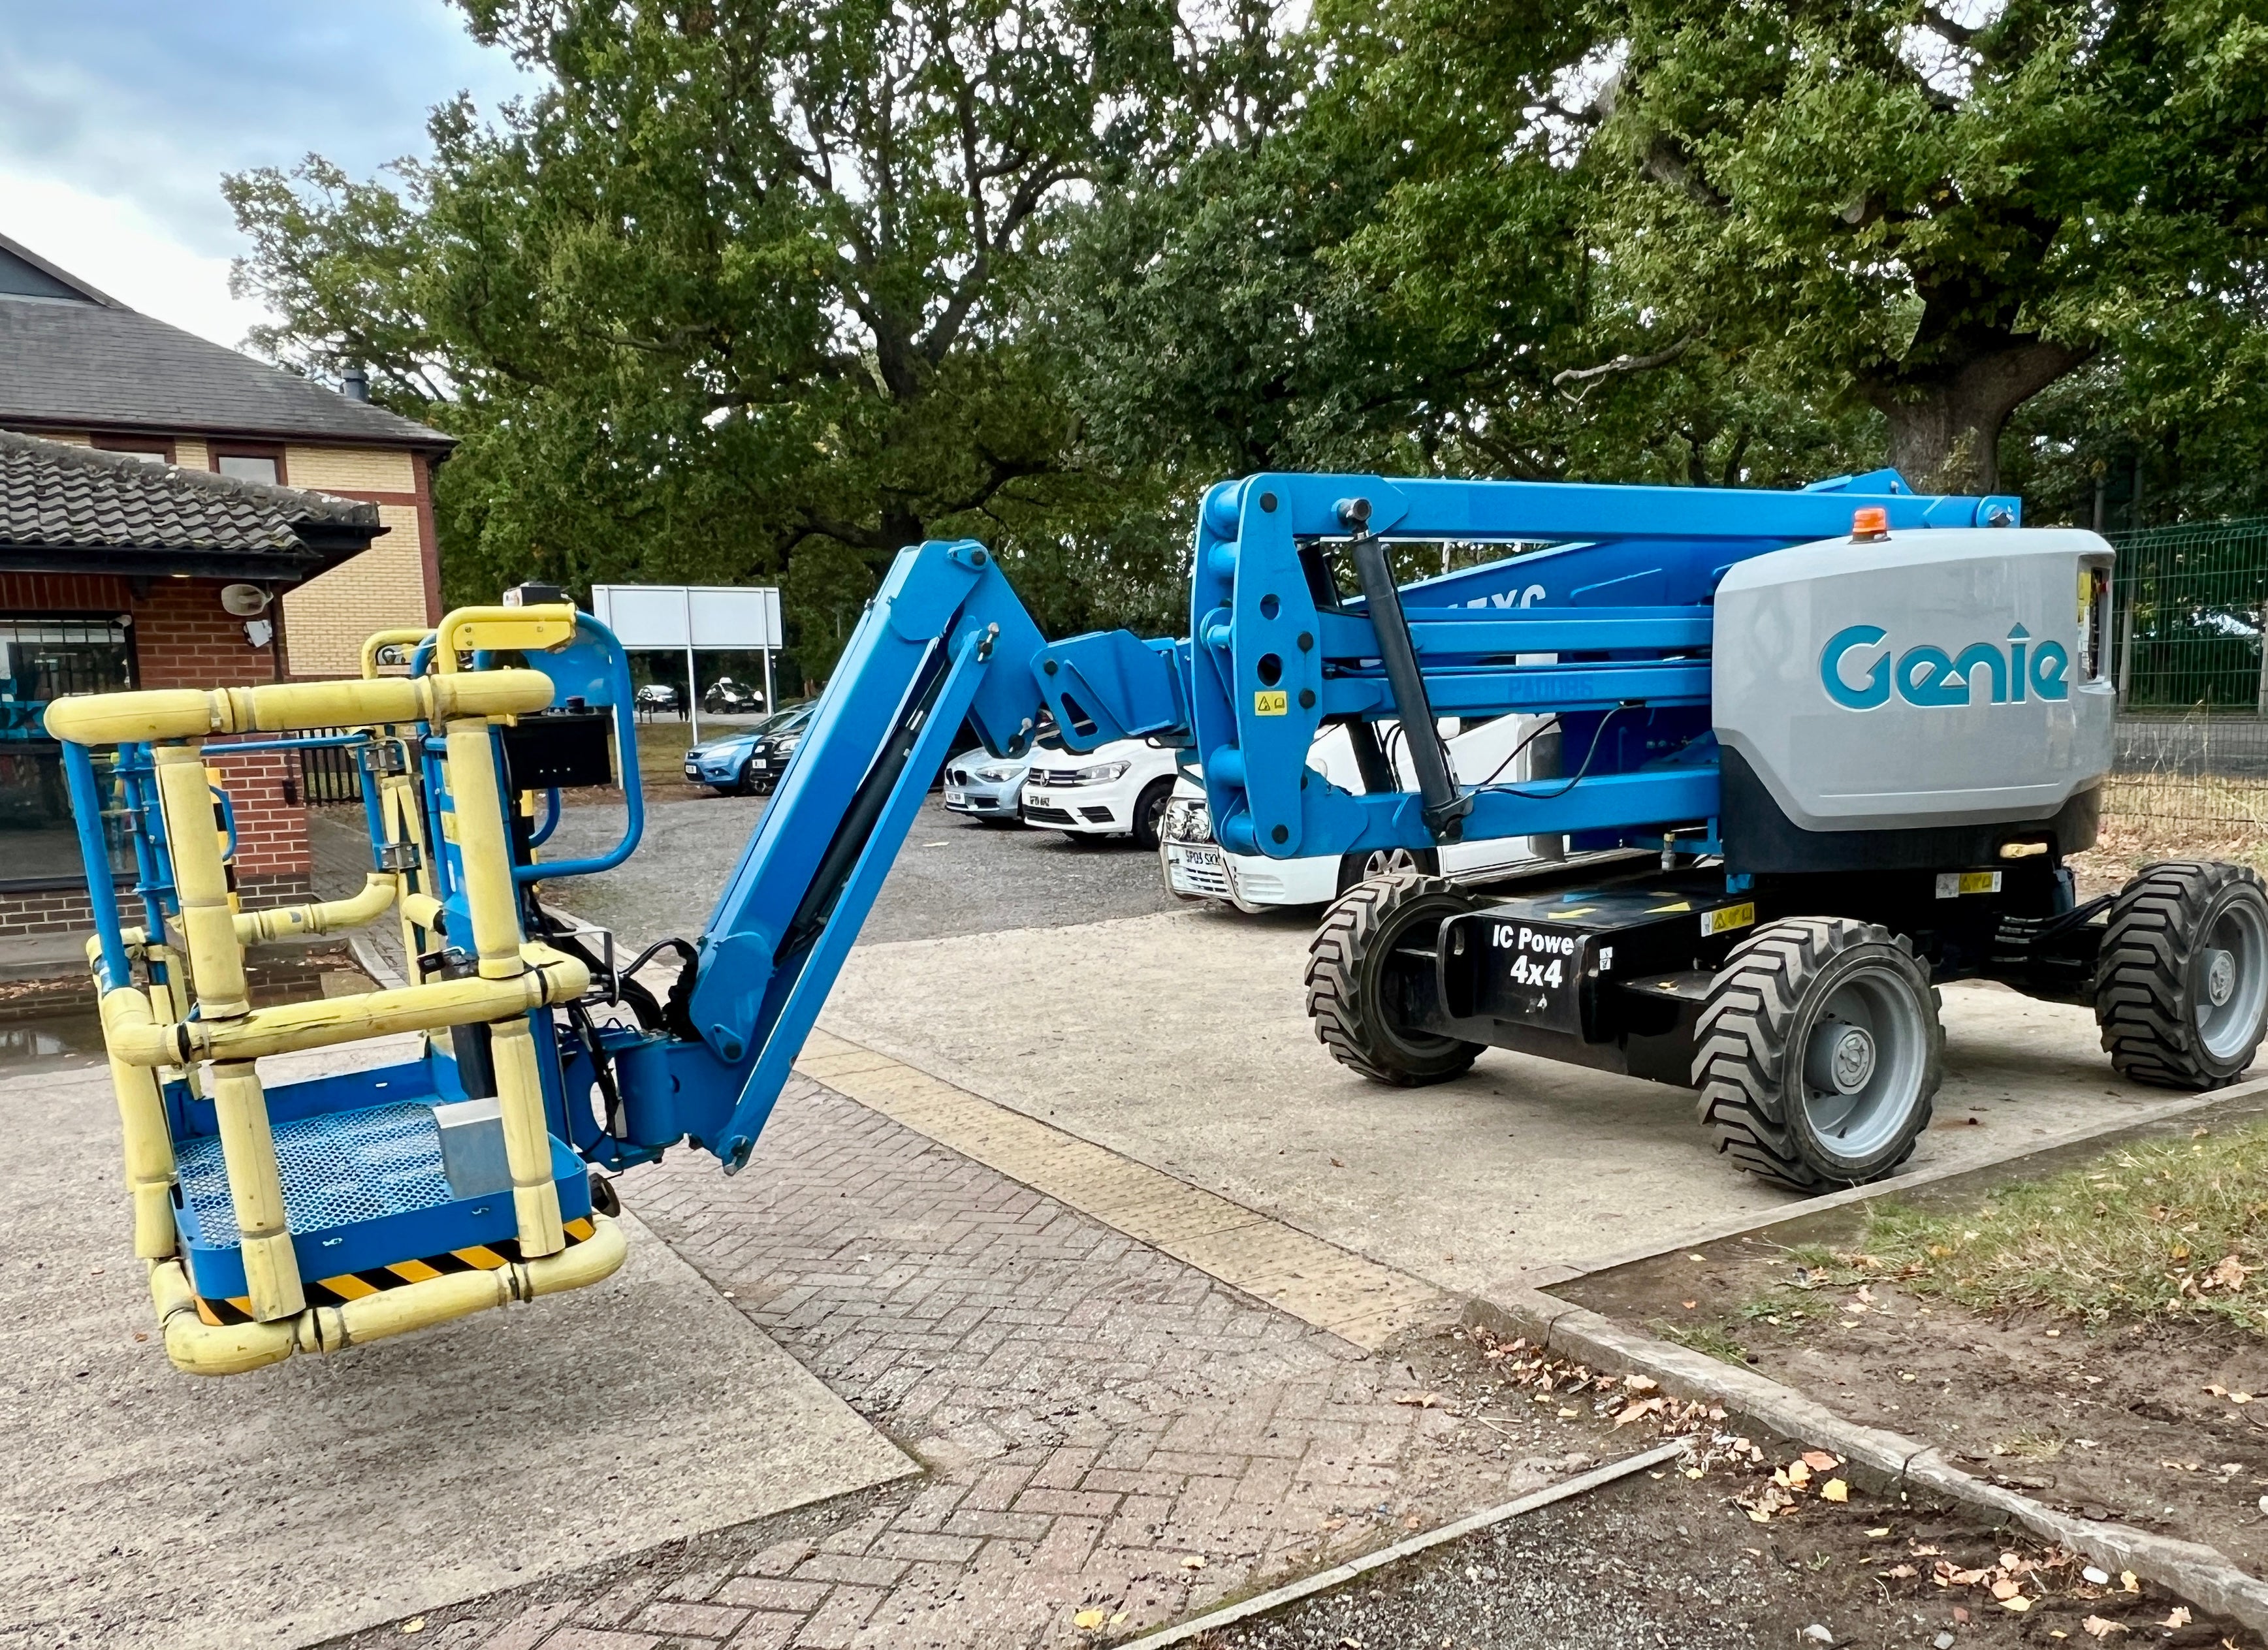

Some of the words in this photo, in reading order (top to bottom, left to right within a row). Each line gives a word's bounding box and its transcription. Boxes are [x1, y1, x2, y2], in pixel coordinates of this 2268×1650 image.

[1818, 622, 2069, 712] Genie
[1492, 925, 1514, 948] IC
[1518, 927, 1575, 955] Powe
[1510, 955, 1563, 989] 4x4
